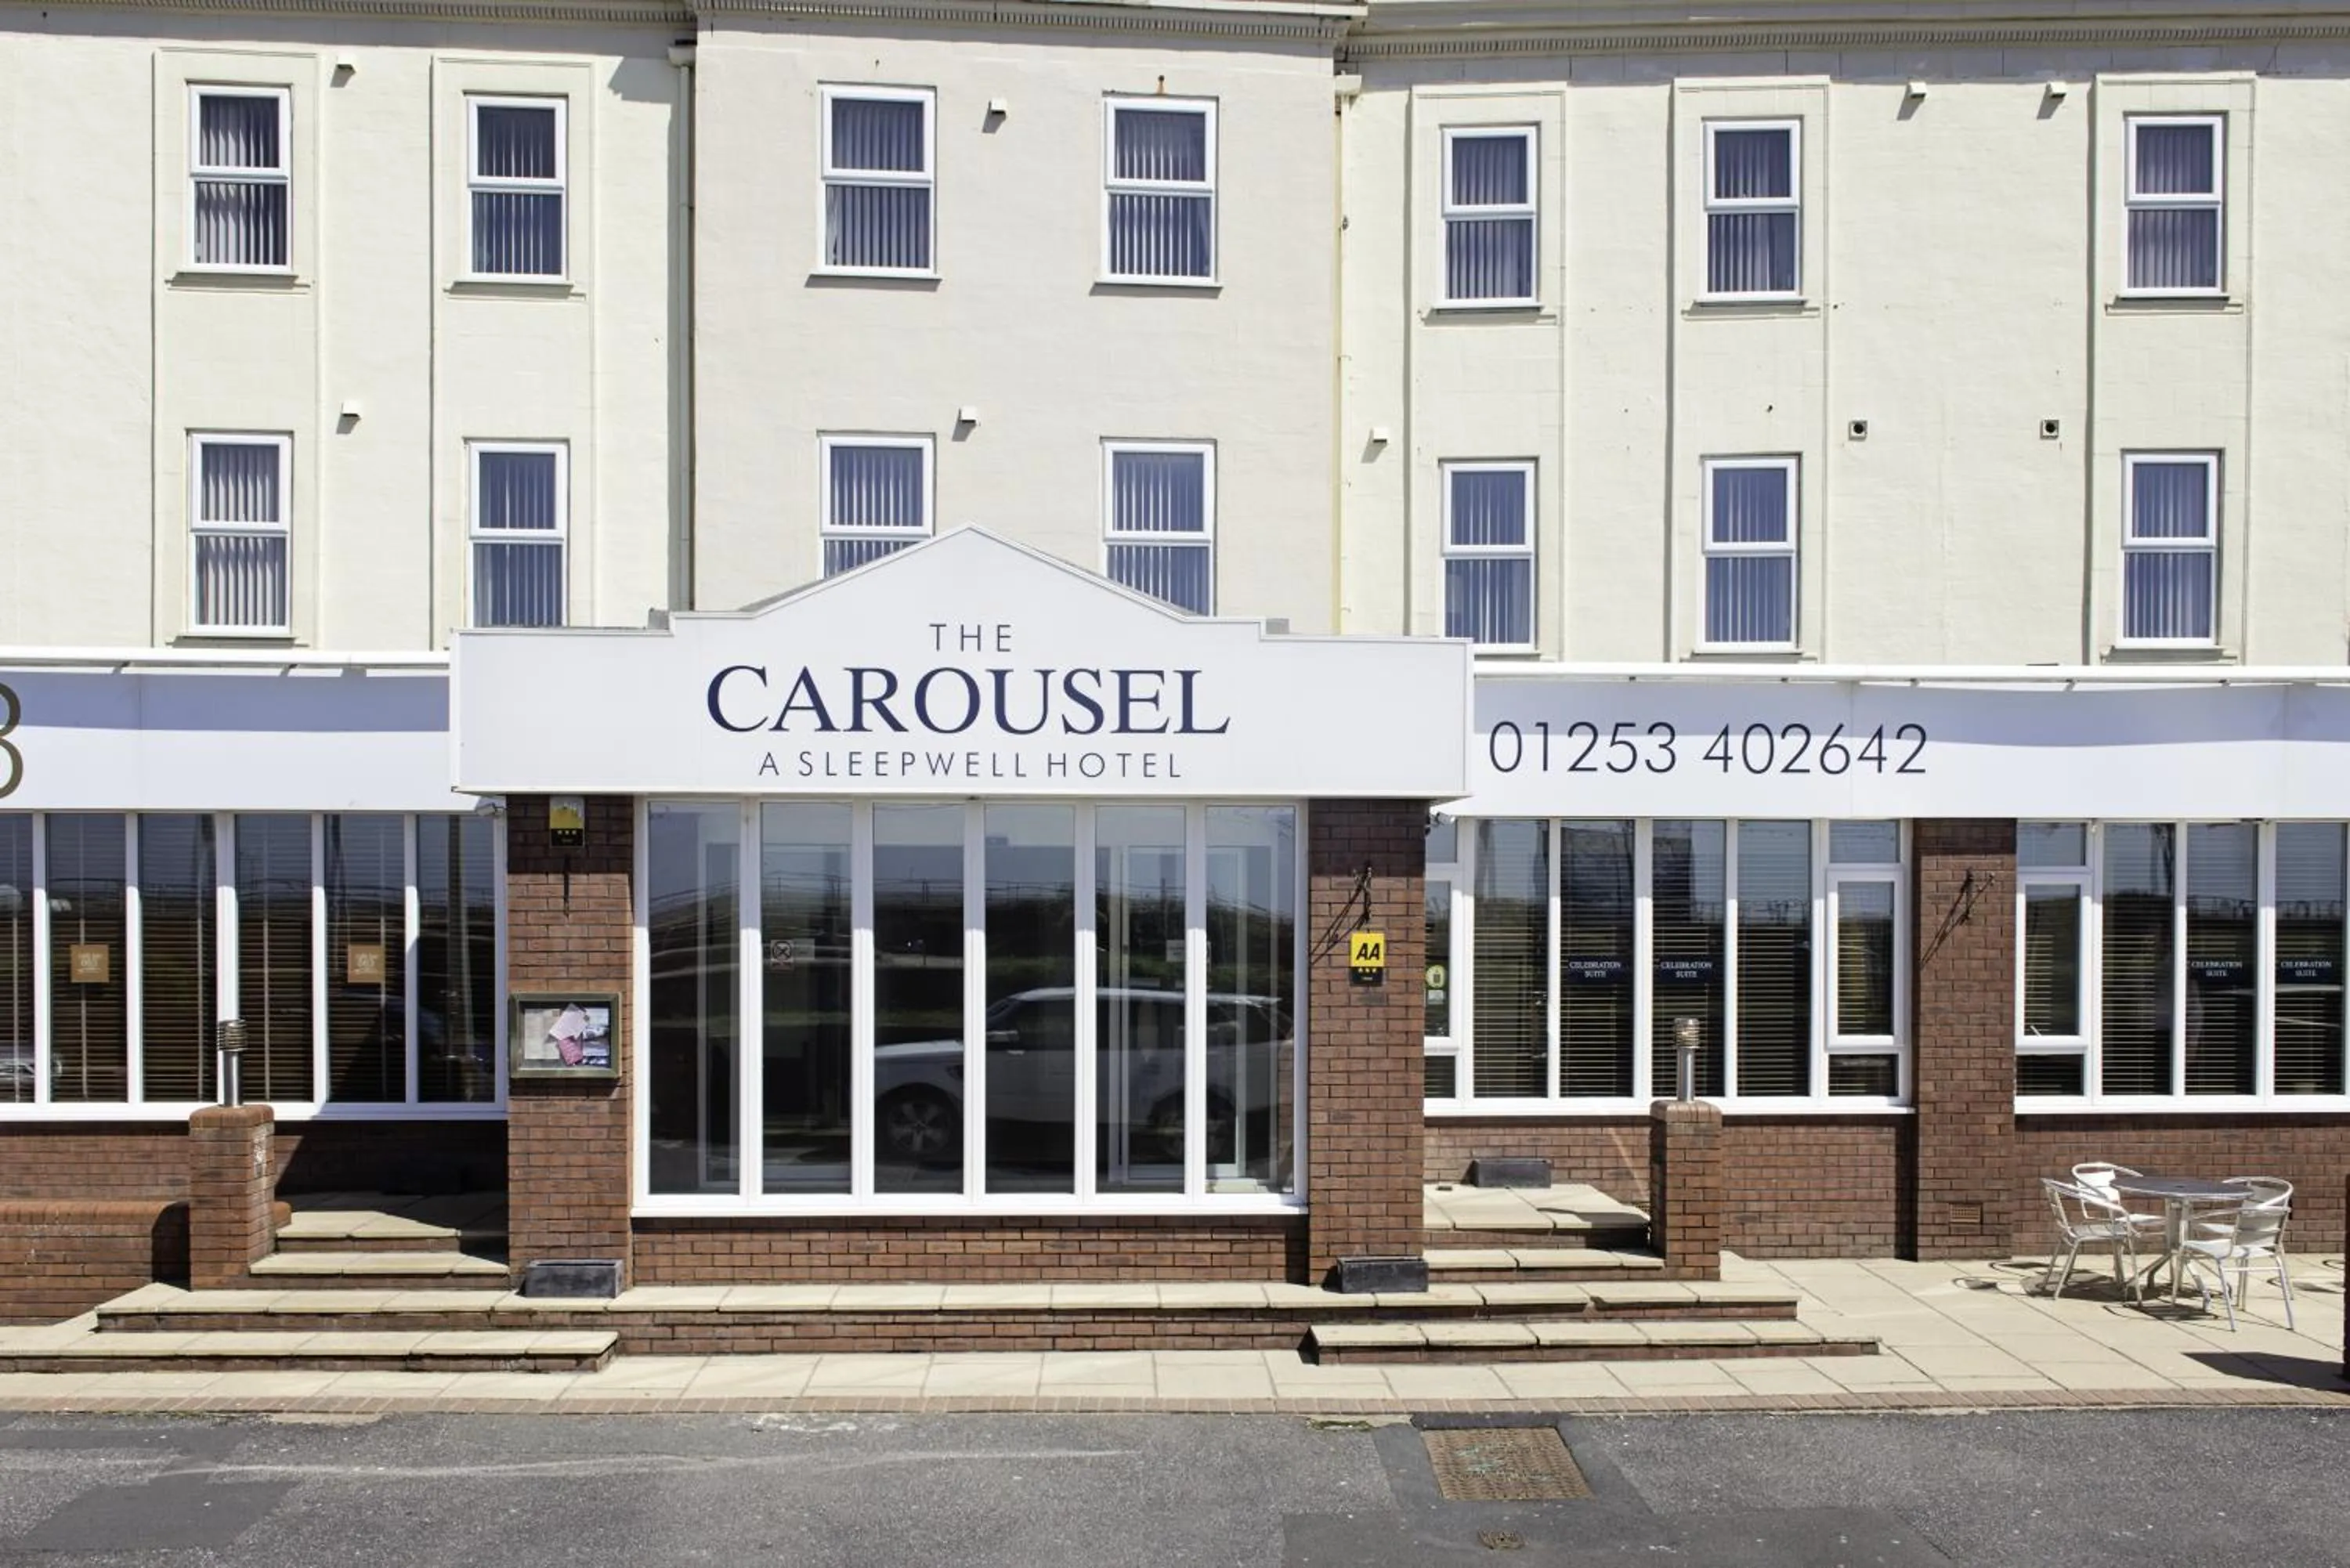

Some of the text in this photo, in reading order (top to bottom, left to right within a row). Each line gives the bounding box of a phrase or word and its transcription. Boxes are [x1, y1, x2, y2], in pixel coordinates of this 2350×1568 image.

[929, 623, 1011, 652] THE
[707, 665, 1231, 735] CAROUSEL
[1489, 721, 1927, 775] 01253 402642
[758, 750, 1181, 778] A SLEEPWELL HOTEL
[1356, 942, 1380, 961] AA
